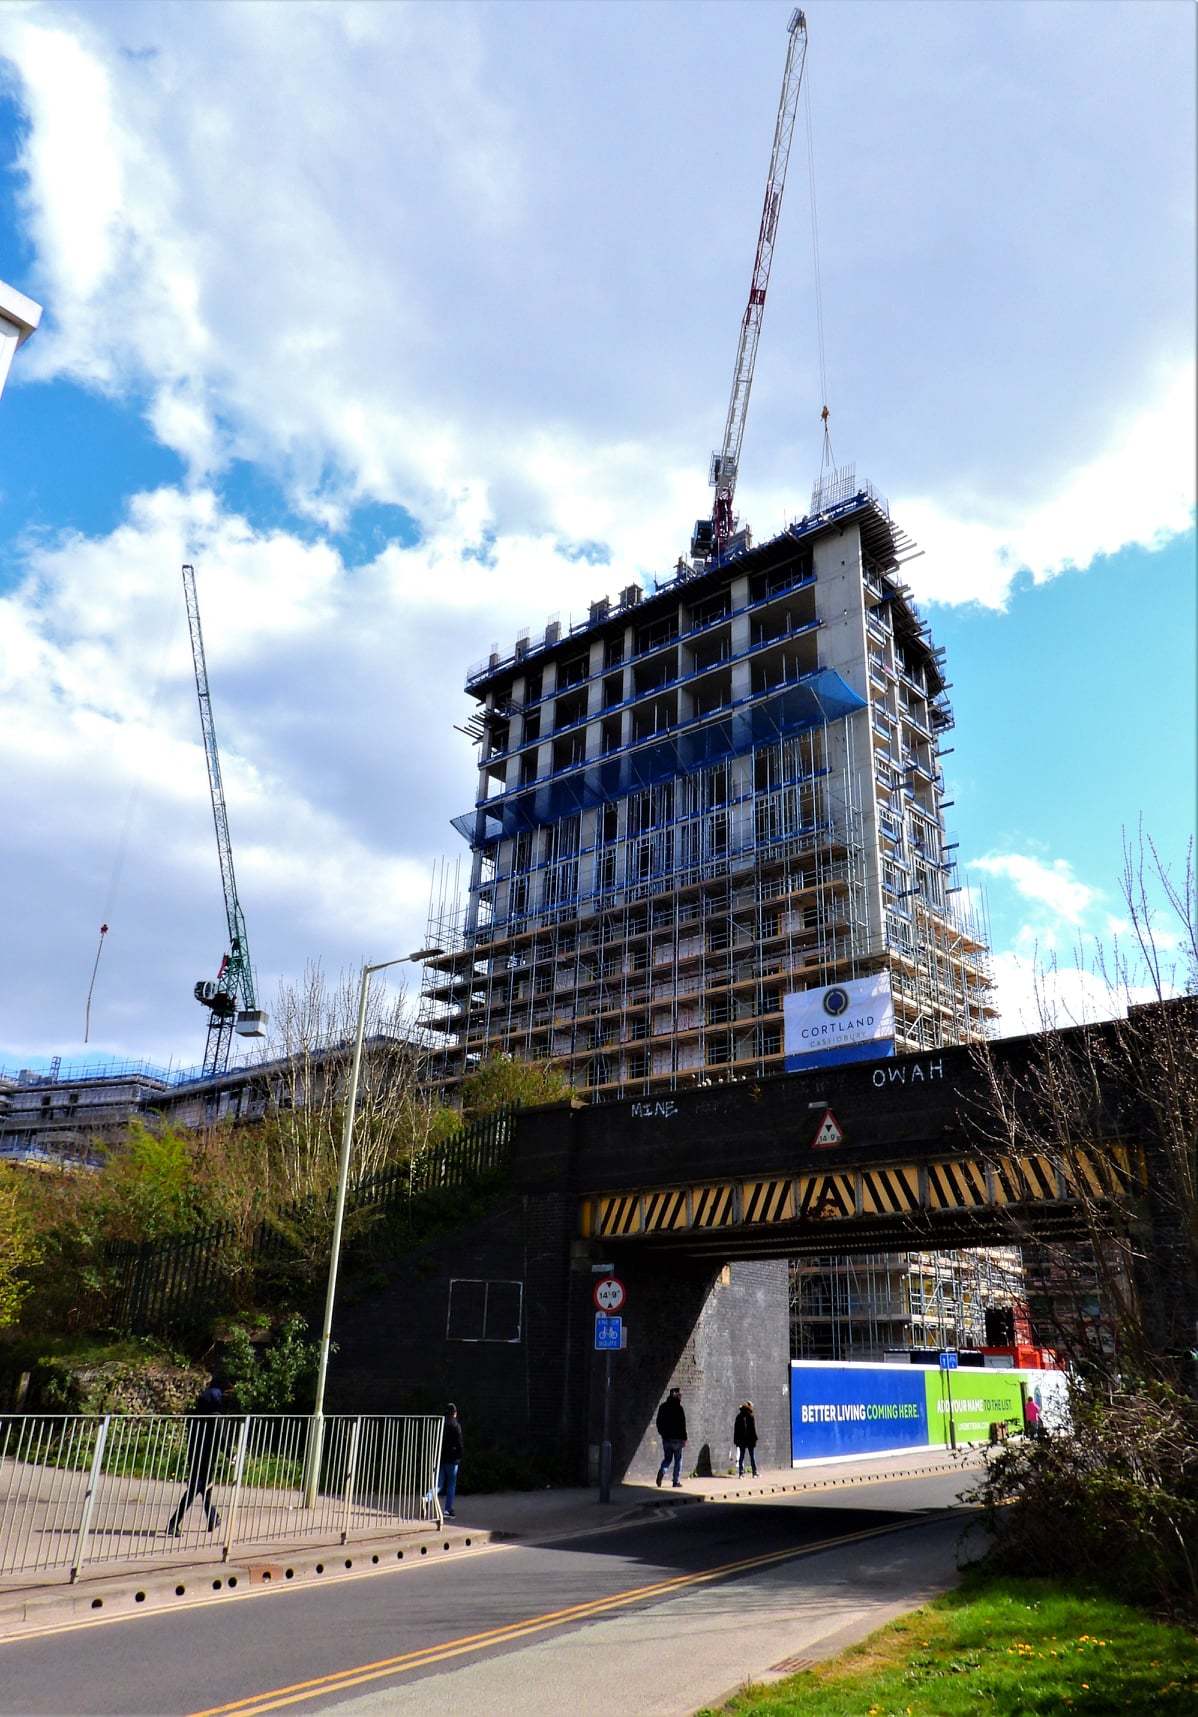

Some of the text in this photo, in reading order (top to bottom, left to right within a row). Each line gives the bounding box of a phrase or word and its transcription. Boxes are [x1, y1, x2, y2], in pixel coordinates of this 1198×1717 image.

[801, 1016, 874, 1039] CORTLAND
[872, 1058, 943, 1087] OWAH
[631, 1101, 678, 1118] MINE
[802, 1403, 920, 1422] BETTER LIVING COMING HERE.
